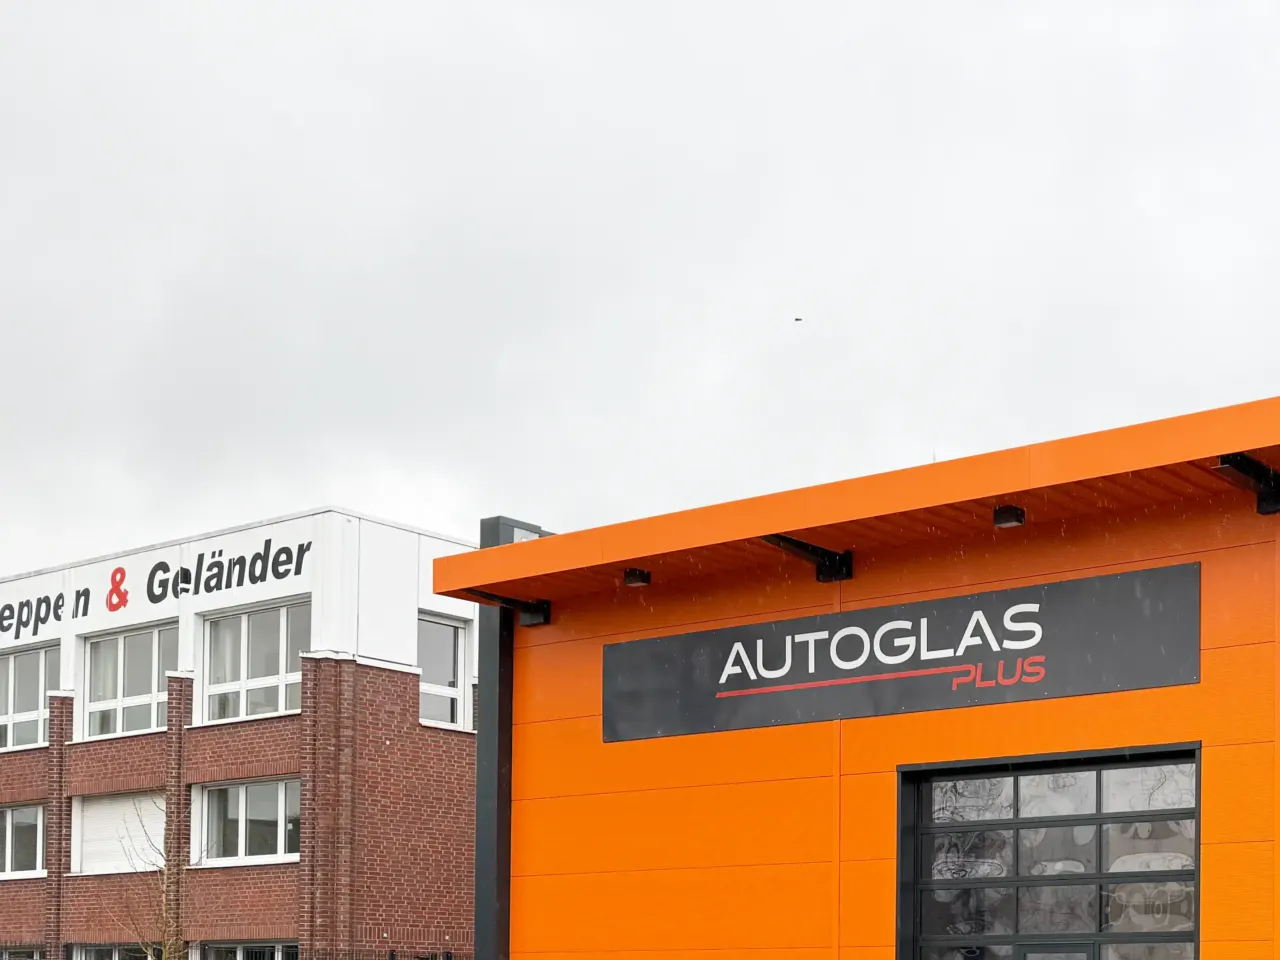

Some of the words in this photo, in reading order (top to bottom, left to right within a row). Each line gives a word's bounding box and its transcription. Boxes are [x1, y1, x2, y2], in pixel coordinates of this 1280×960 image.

[106, 567, 128, 612] &
[147, 539, 312, 604] Geländer
[719, 603, 1043, 684] AUTOGLAS
[952, 656, 1046, 690] PLUS
